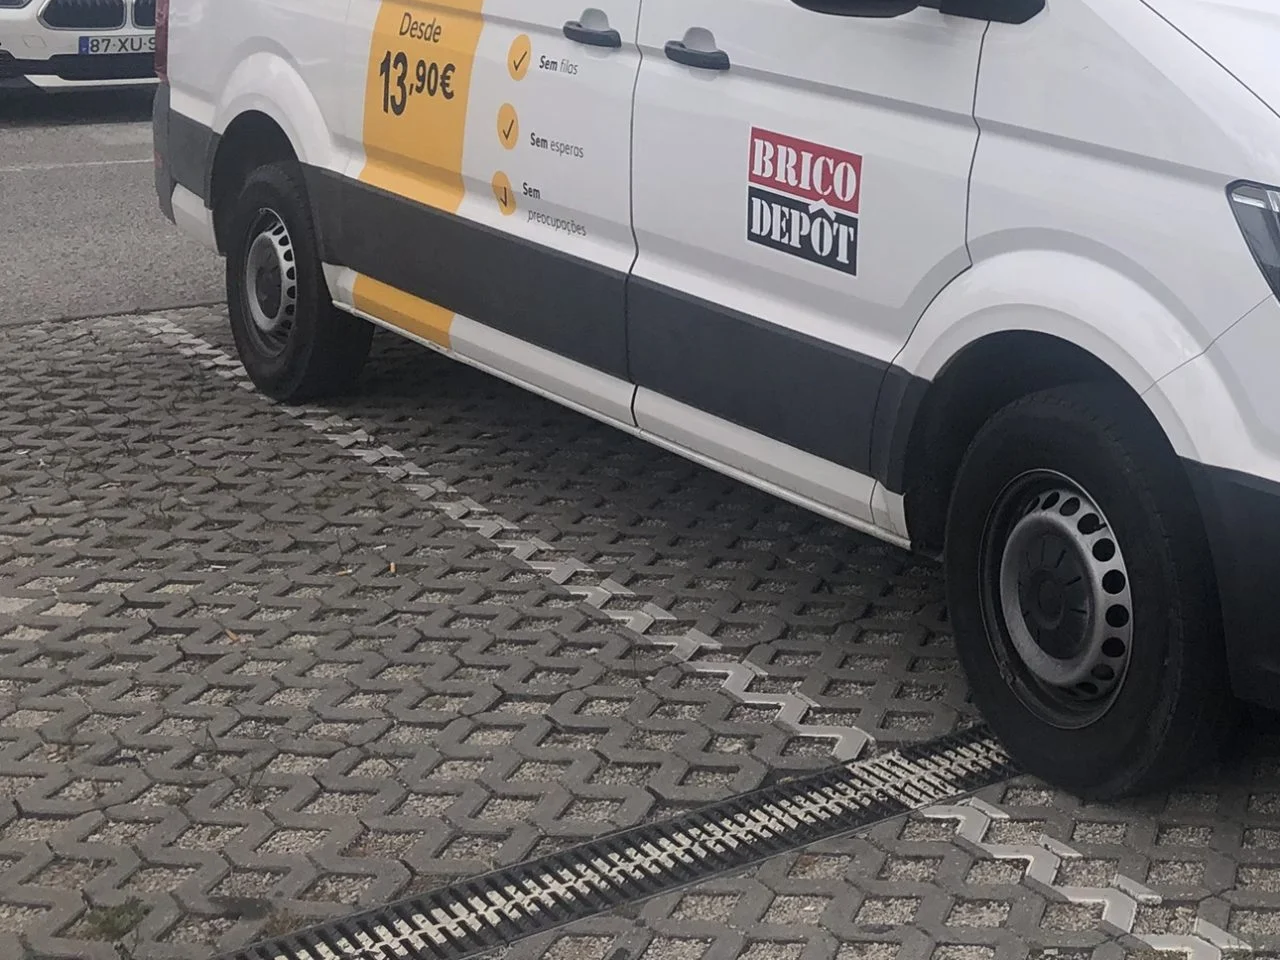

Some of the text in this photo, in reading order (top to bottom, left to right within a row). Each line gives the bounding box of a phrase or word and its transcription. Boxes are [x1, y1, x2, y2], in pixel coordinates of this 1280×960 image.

[399, 11, 442, 43] Desde
[539, 55, 578, 75] Sem filas
[379, 50, 456, 117] 13,90€
[530, 132, 584, 159] Sem esperas
[752, 138, 857, 202] BRICO
[522, 182, 541, 200] Sem
[527, 208, 587, 237] preocupações
